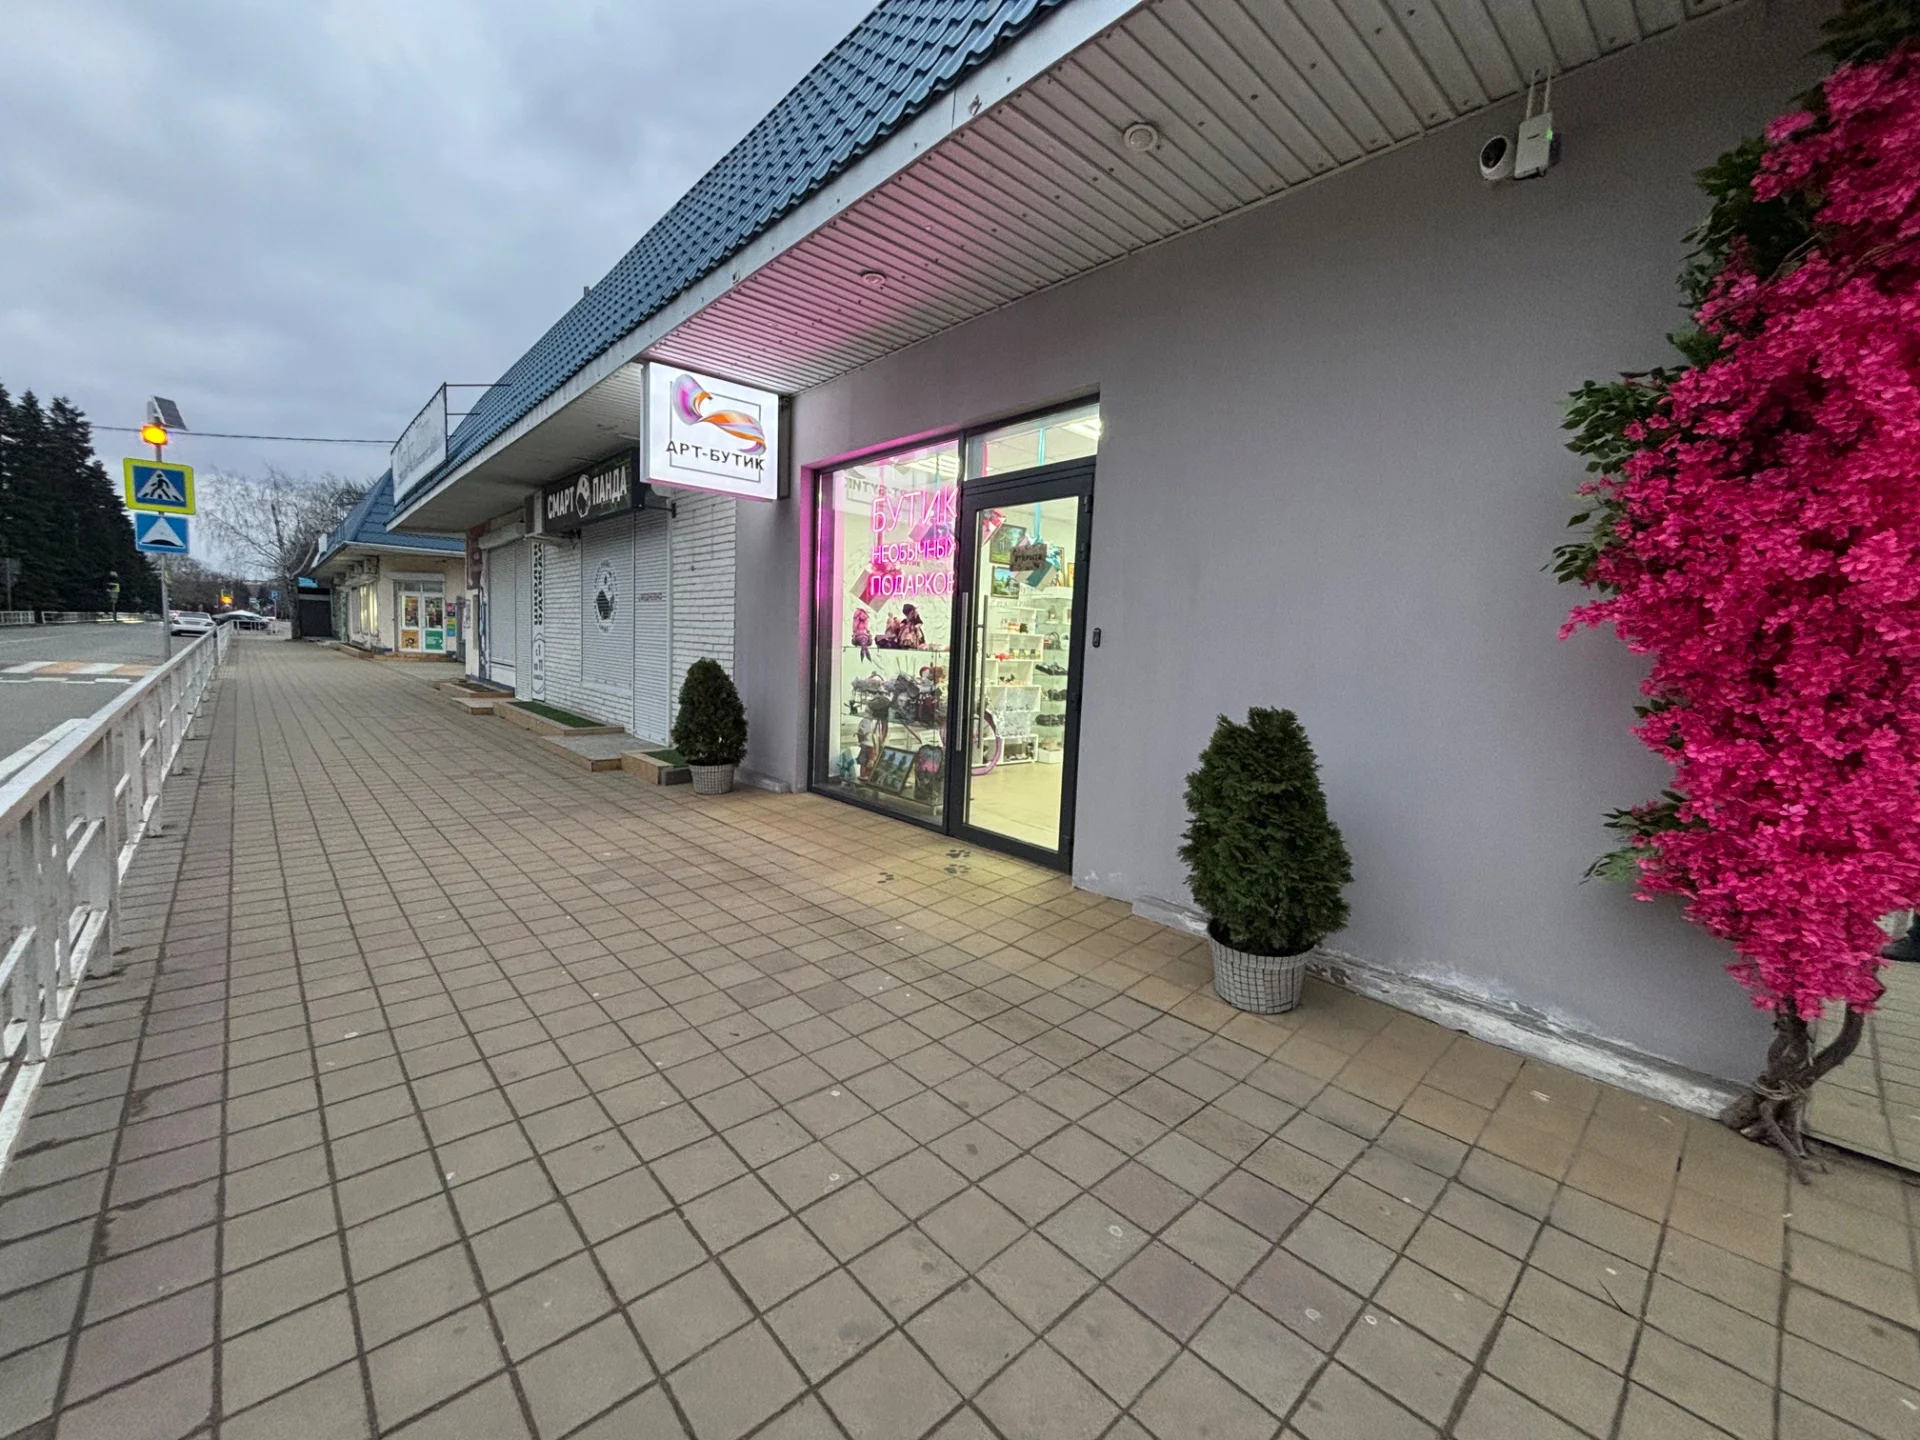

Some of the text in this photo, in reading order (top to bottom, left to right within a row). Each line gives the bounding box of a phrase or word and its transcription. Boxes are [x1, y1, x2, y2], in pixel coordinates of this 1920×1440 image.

[666, 440, 764, 471] АРТ-БУТИК
[547, 466, 627, 519] СМАРТ ПАНДА
[872, 485, 958, 533] БУТИК
